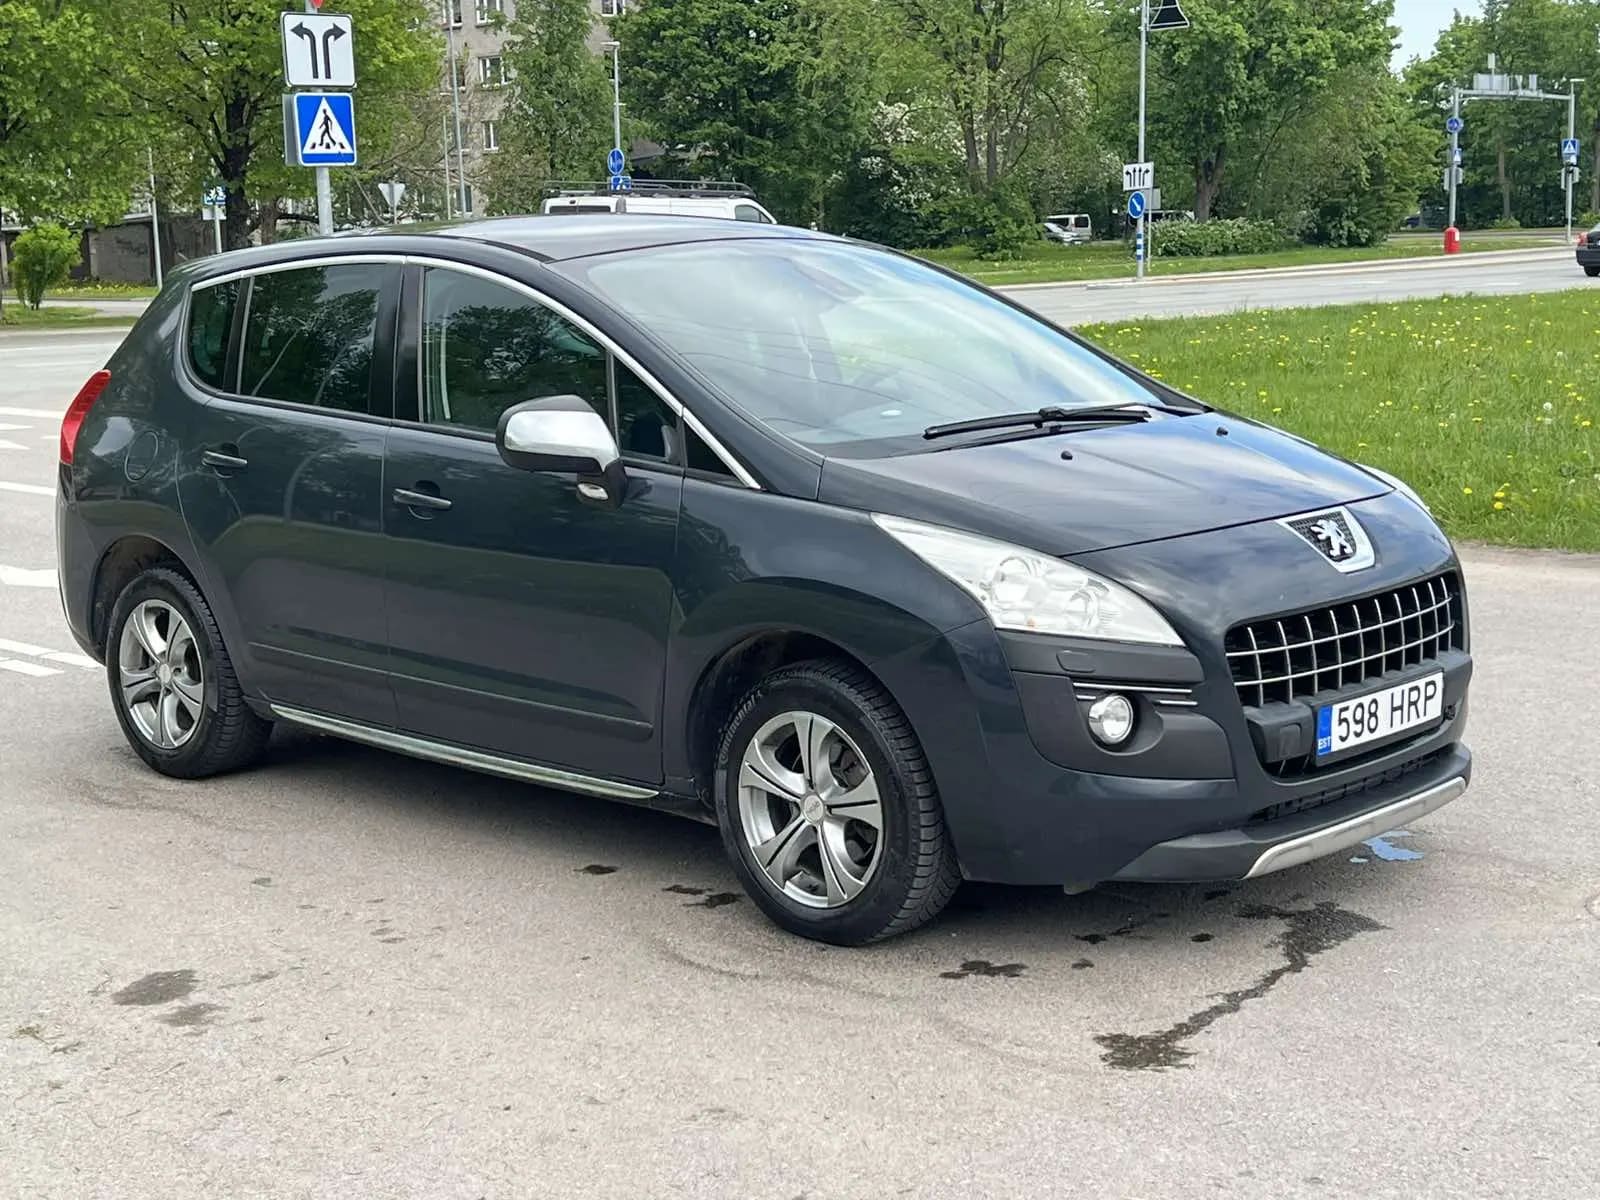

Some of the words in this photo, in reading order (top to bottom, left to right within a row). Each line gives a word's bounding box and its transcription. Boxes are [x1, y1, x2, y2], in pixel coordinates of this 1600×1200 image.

[1337, 698, 1379, 743] 598
[1390, 680, 1437, 728] HRP
[1318, 736, 1332, 750] EST
